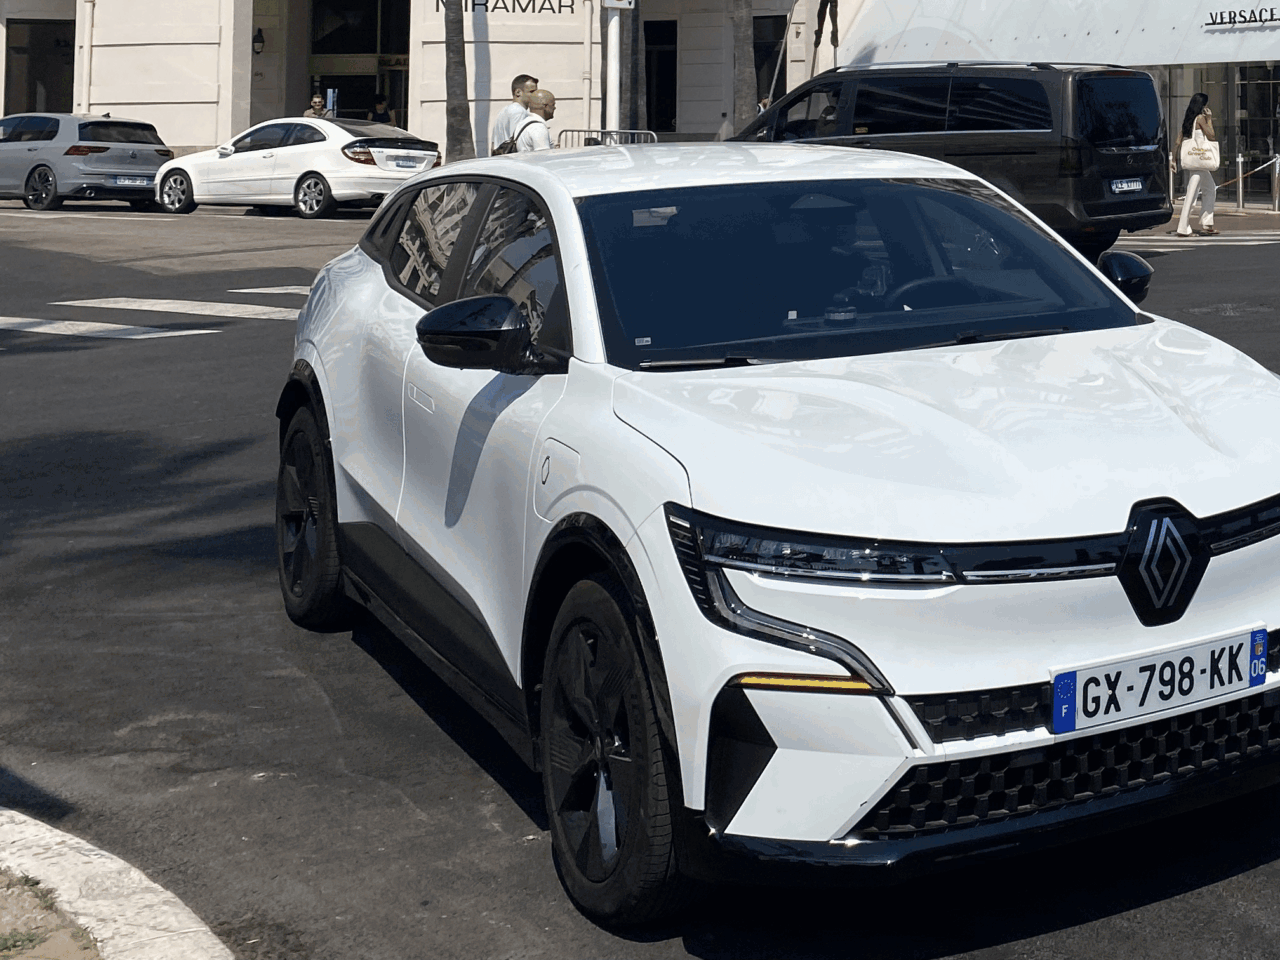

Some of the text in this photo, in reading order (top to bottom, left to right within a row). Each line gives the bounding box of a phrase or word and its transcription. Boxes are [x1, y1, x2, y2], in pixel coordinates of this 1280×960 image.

[1209, 7, 1278, 25] VERSACE
[1251, 657, 1266, 677] 06
[1082, 642, 1245, 718] GX-798-KK
[1061, 704, 1069, 718] F
